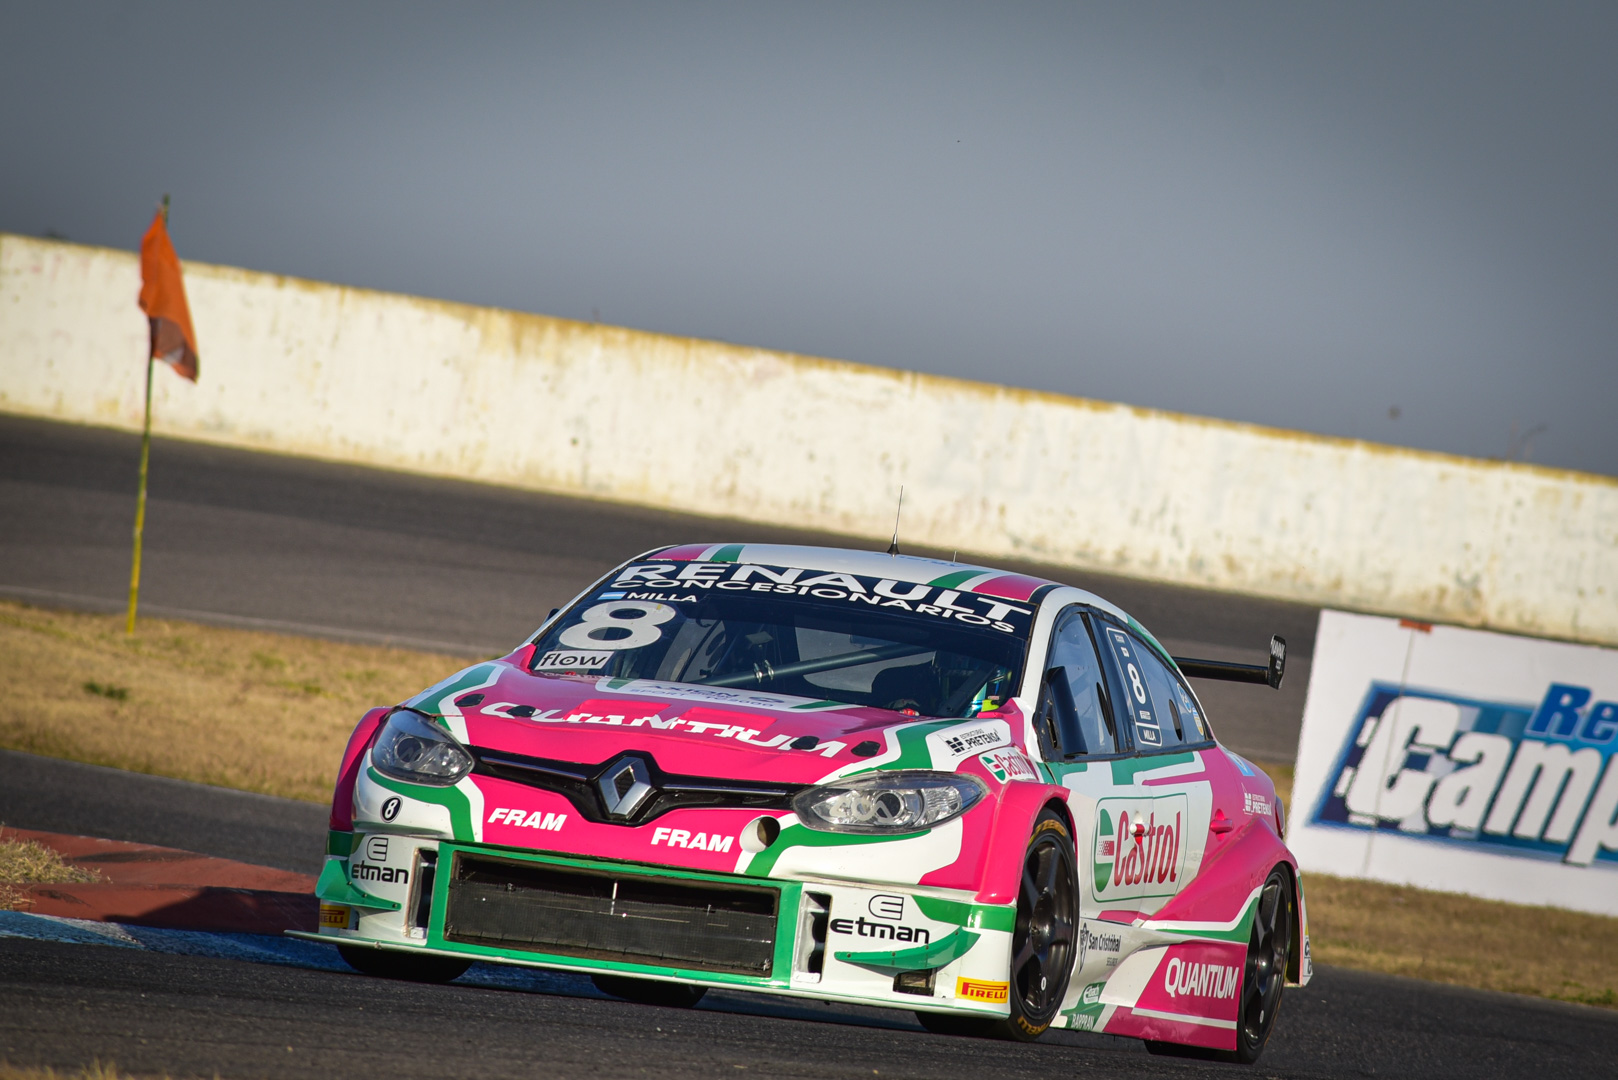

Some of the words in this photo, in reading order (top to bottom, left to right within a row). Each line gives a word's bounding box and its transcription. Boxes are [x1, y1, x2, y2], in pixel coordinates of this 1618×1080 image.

[615, 563, 1032, 621] RENAULT
[627, 592, 697, 603] MILLA
[610, 580, 1015, 633] CONCESIONARIOS
[558, 600, 676, 650] 8
[540, 653, 607, 667] flow
[1127, 663, 1146, 704] 8
[385, 799, 396, 820] 8
[487, 807, 568, 832] FRAM
[651, 827, 734, 853] FRAM
[1114, 810, 1181, 887] Castrol
[351, 861, 409, 884] etman
[830, 917, 930, 944] etman
[962, 982, 1007, 999] PIRELLI
[1164, 957, 1240, 1000] QUANTIUM
